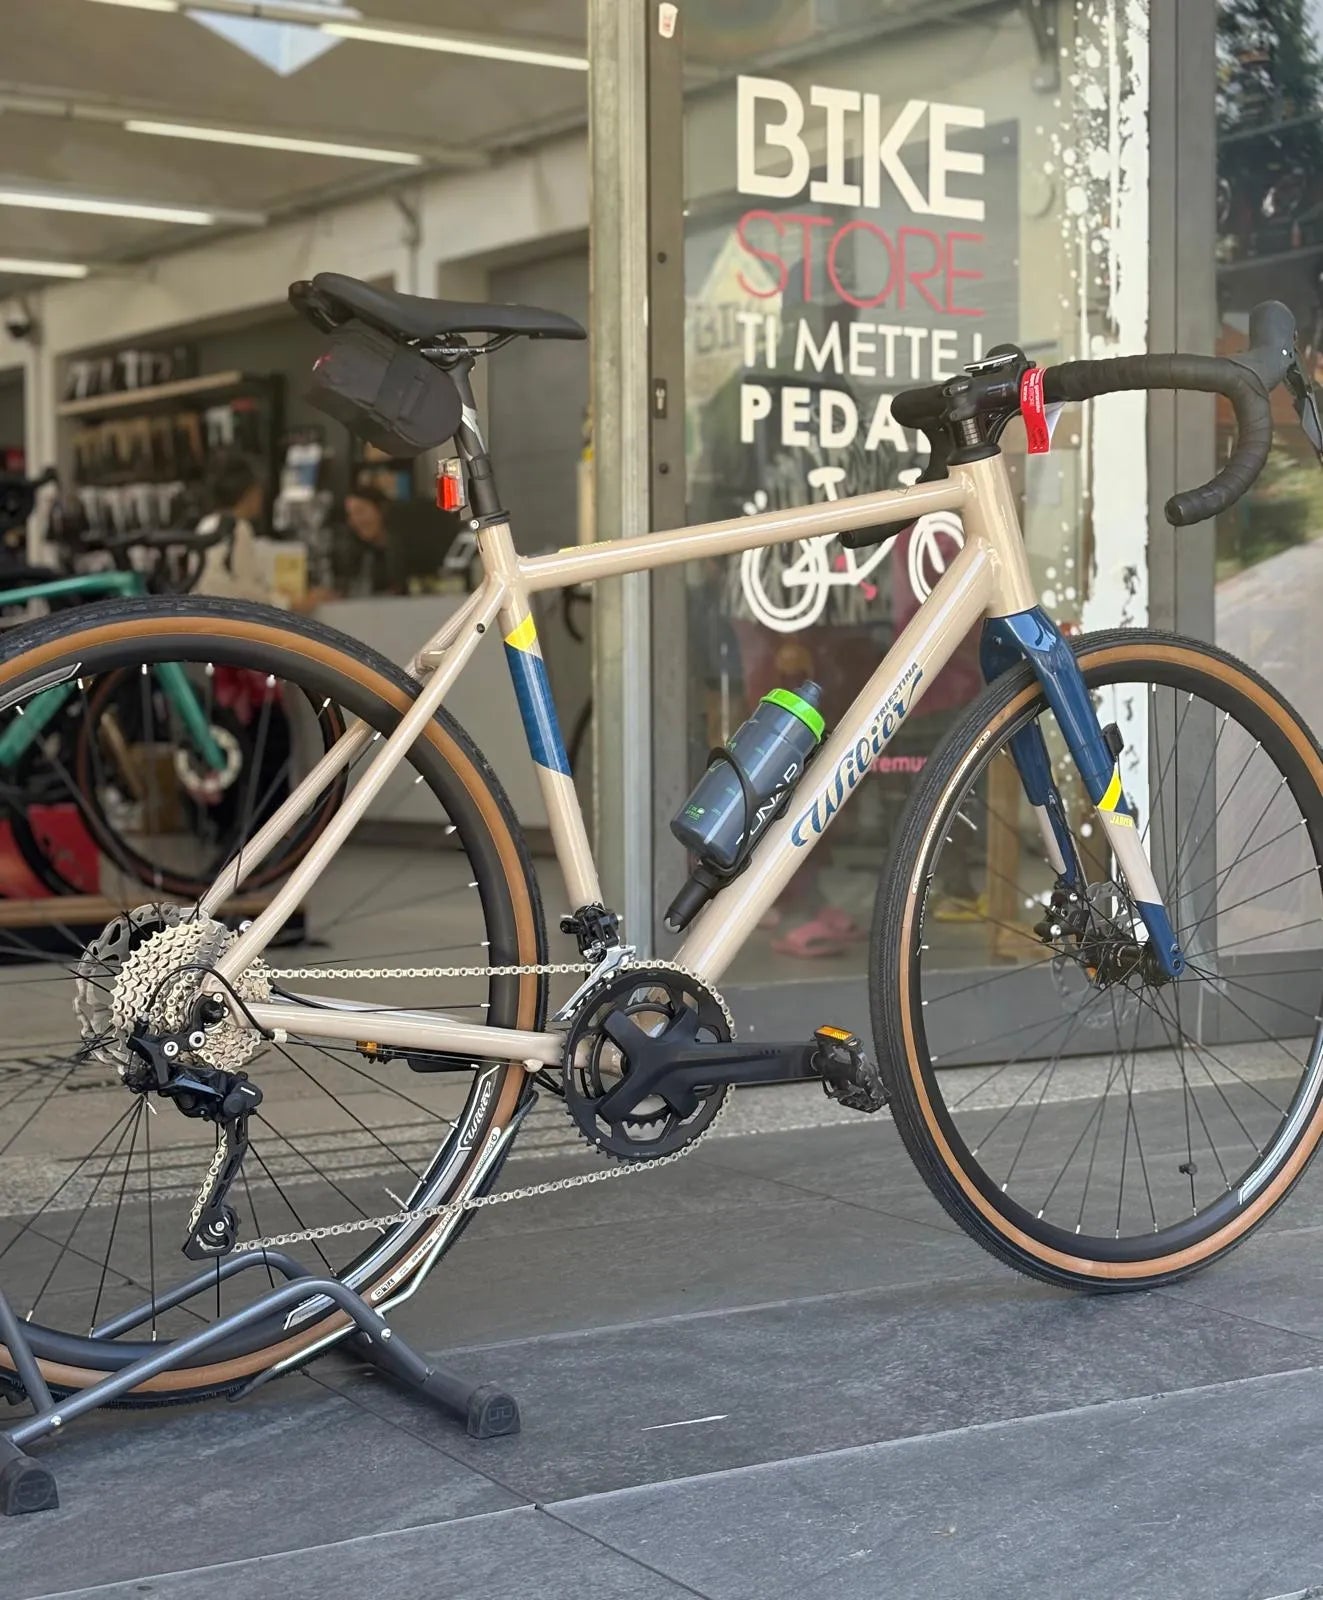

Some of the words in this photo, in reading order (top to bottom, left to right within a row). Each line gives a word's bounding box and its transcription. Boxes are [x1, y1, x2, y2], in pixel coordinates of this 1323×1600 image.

[737, 75, 985, 222] BIKE
[736, 209, 985, 317] STORE
[737, 312, 776, 369] TI
[794, 318, 957, 382] METTE
[874, 662, 919, 723] TRIESTINA
[791, 669, 923, 847] Wilier
